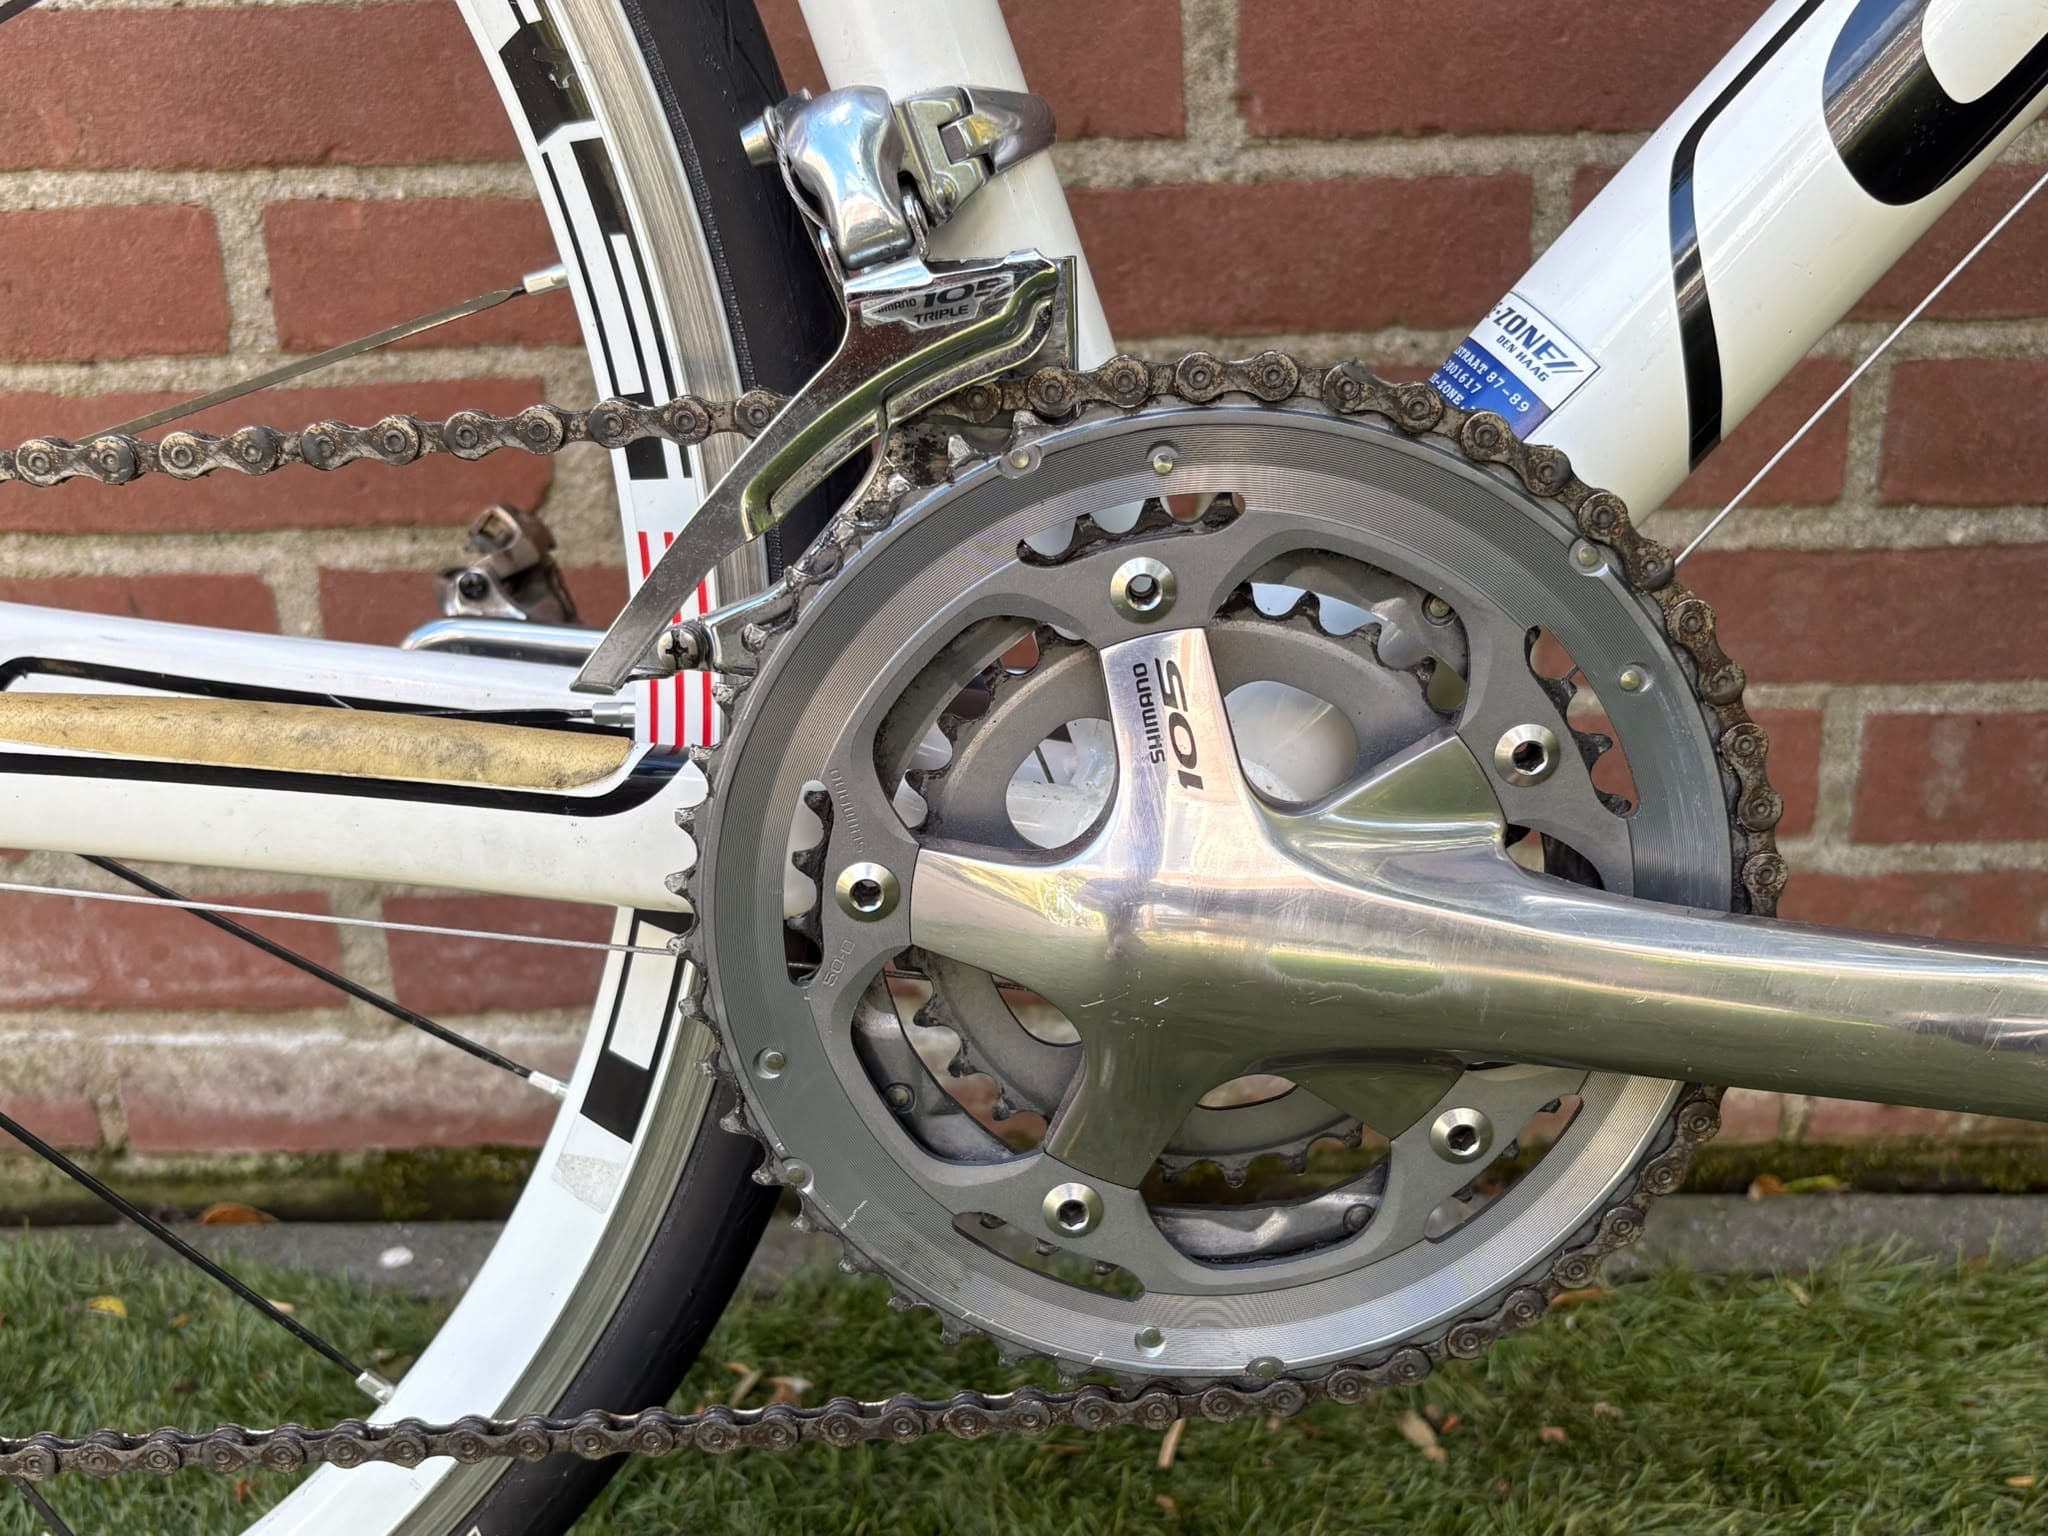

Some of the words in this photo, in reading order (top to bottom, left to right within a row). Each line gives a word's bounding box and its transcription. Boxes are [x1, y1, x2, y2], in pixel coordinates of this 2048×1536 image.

[914, 304, 969, 324] TRIPLE
[922, 275, 1004, 308] 105
[1488, 302, 1573, 366] -ZONE
[1495, 334, 1518, 354] DEN
[1515, 352, 1550, 382] HAAG
[1132, 662, 1166, 764] SHIMANO
[1154, 657, 1204, 790] 105
